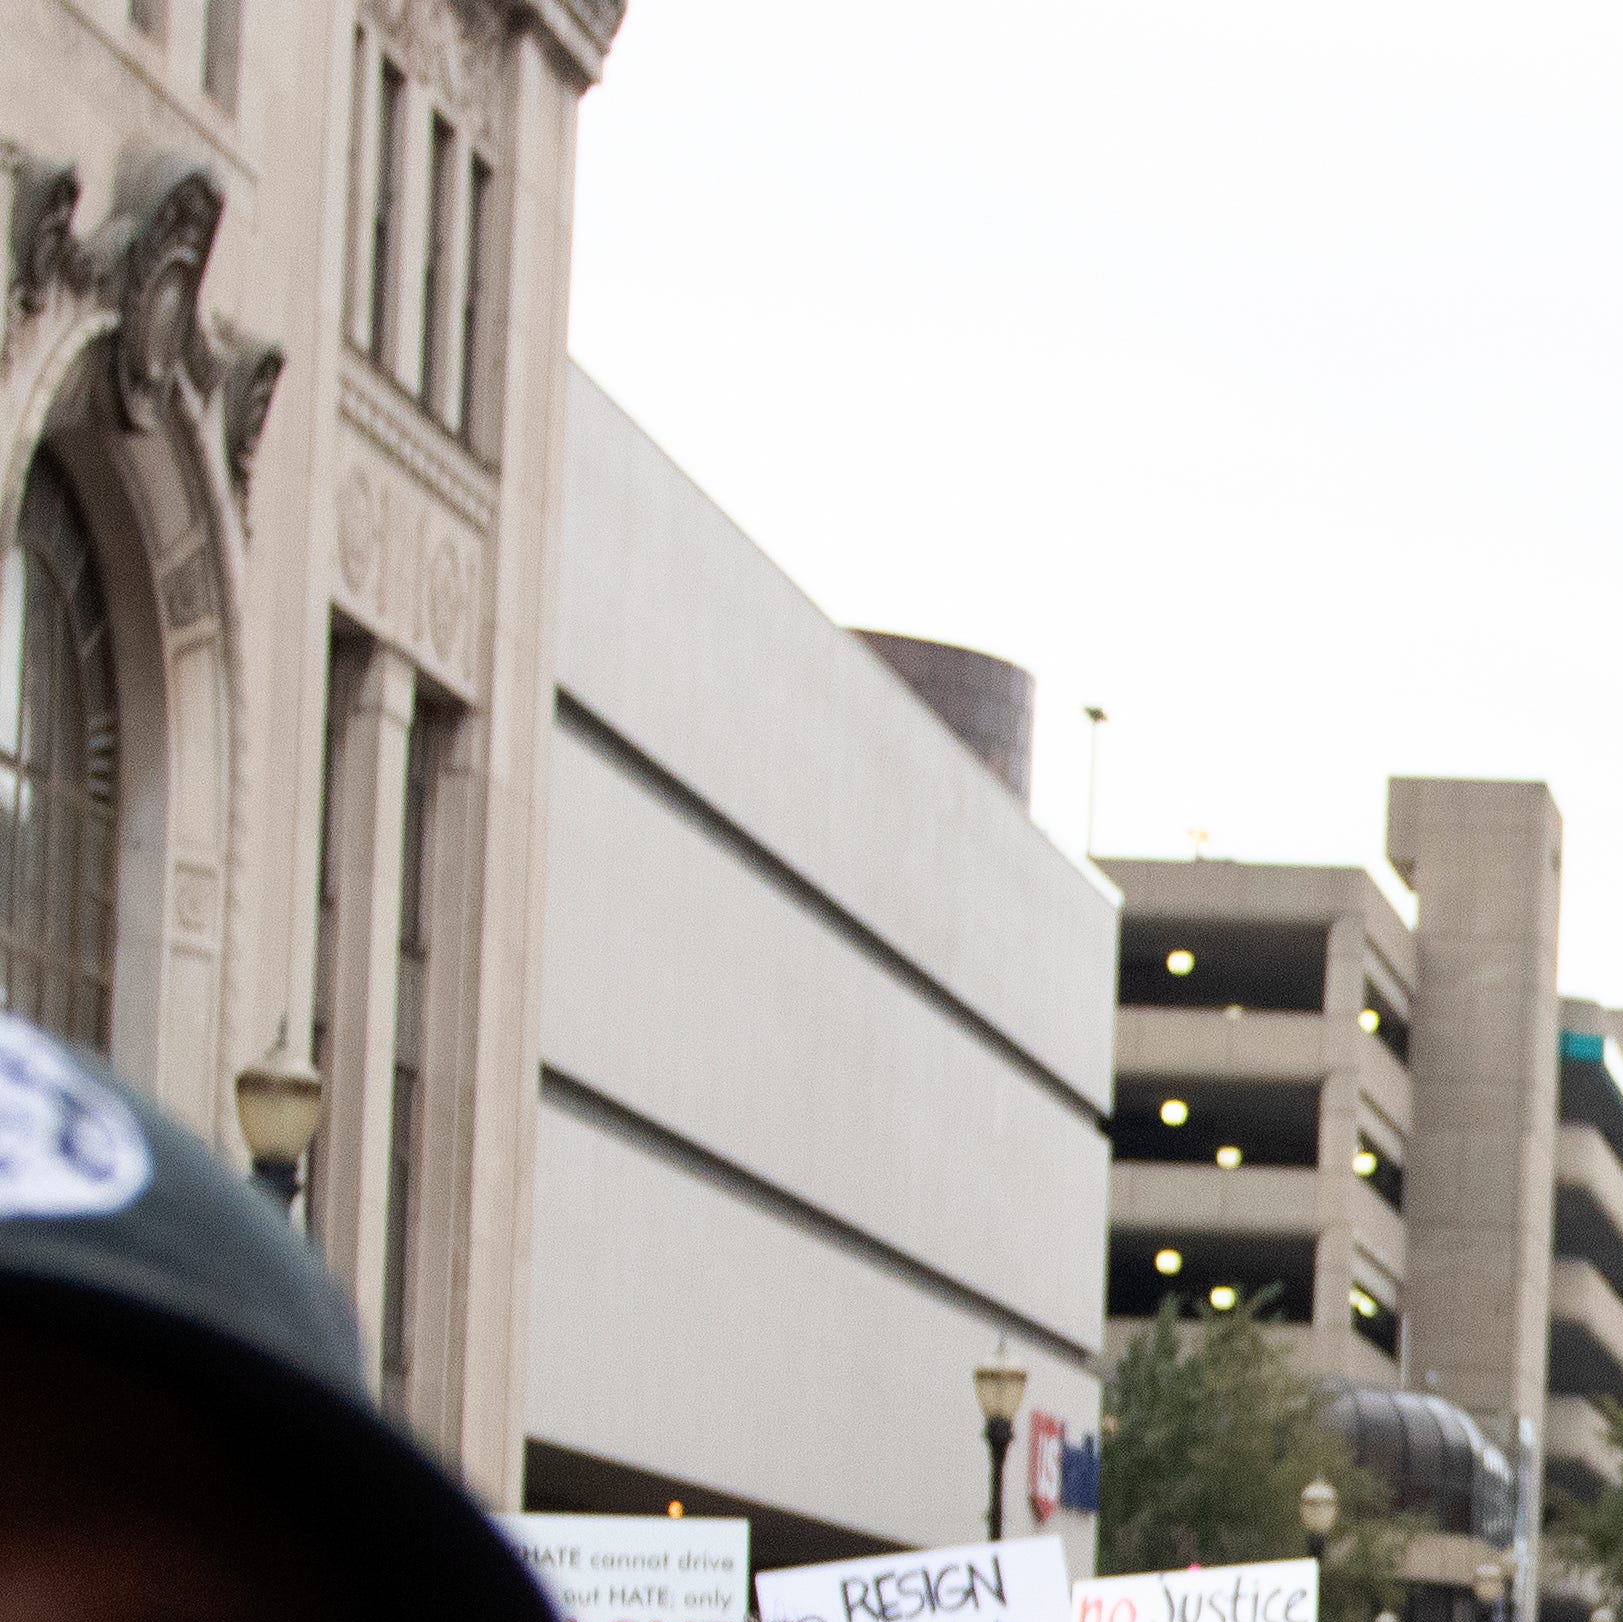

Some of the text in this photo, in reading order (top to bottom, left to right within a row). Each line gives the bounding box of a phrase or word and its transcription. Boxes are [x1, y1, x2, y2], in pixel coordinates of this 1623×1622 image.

[590, 1550, 669, 1571] cannot
[677, 1550, 734, 1572] drive
[683, 1586, 732, 1612] only
